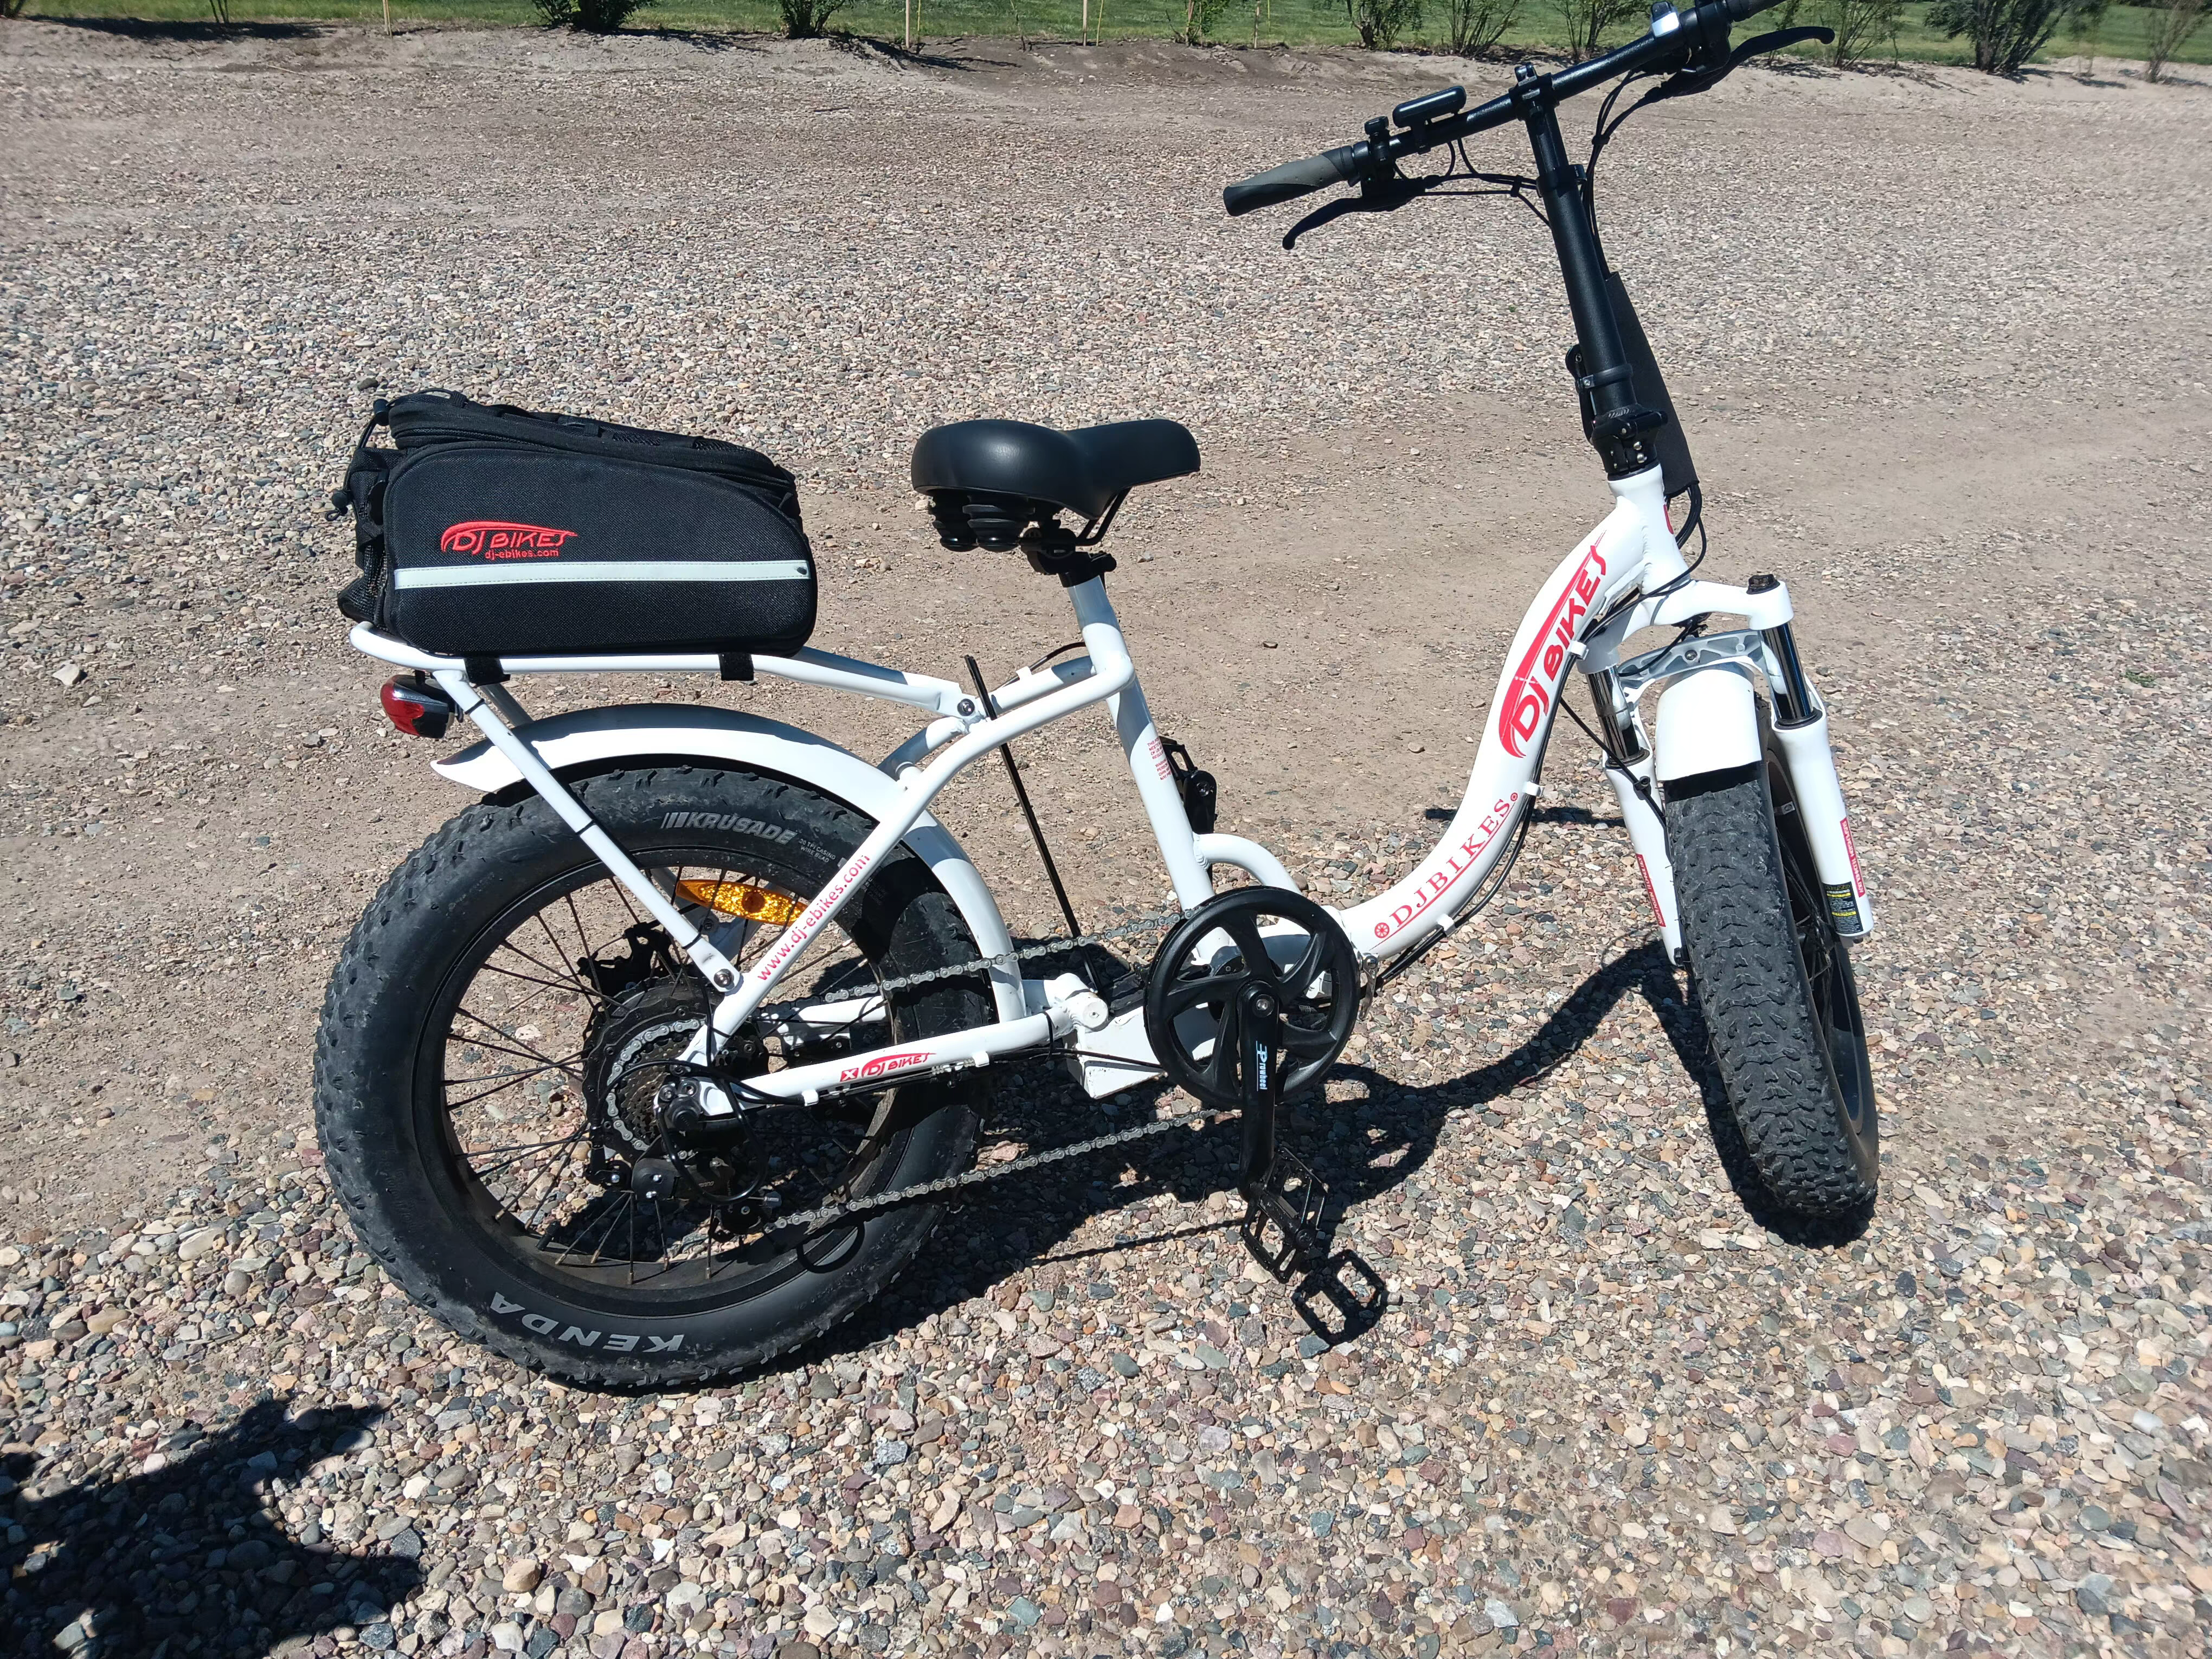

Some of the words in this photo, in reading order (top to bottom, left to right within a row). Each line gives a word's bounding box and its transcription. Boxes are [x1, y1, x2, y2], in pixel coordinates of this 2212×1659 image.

[453, 530, 486, 556] DJ
[490, 531, 569, 548] BIKES
[485, 549, 559, 561] dj-ebikes.com
[1509, 676, 1549, 743] DJ
[1544, 545, 1607, 683] BIKES
[684, 812, 798, 845] KRUSADE
[800, 845, 815, 856] WIRE
[814, 852, 829, 863] BEAD
[807, 841, 816, 850] TPI
[816, 846, 836, 860] CASING
[757, 855, 871, 980] www.dj-ebikes.com
[867, 1062, 886, 1076] DJ
[888, 1052, 930, 1071] BIKES
[1256, 1045, 1268, 1090] Prowheel
[490, 1291, 685, 1353] KENDA
